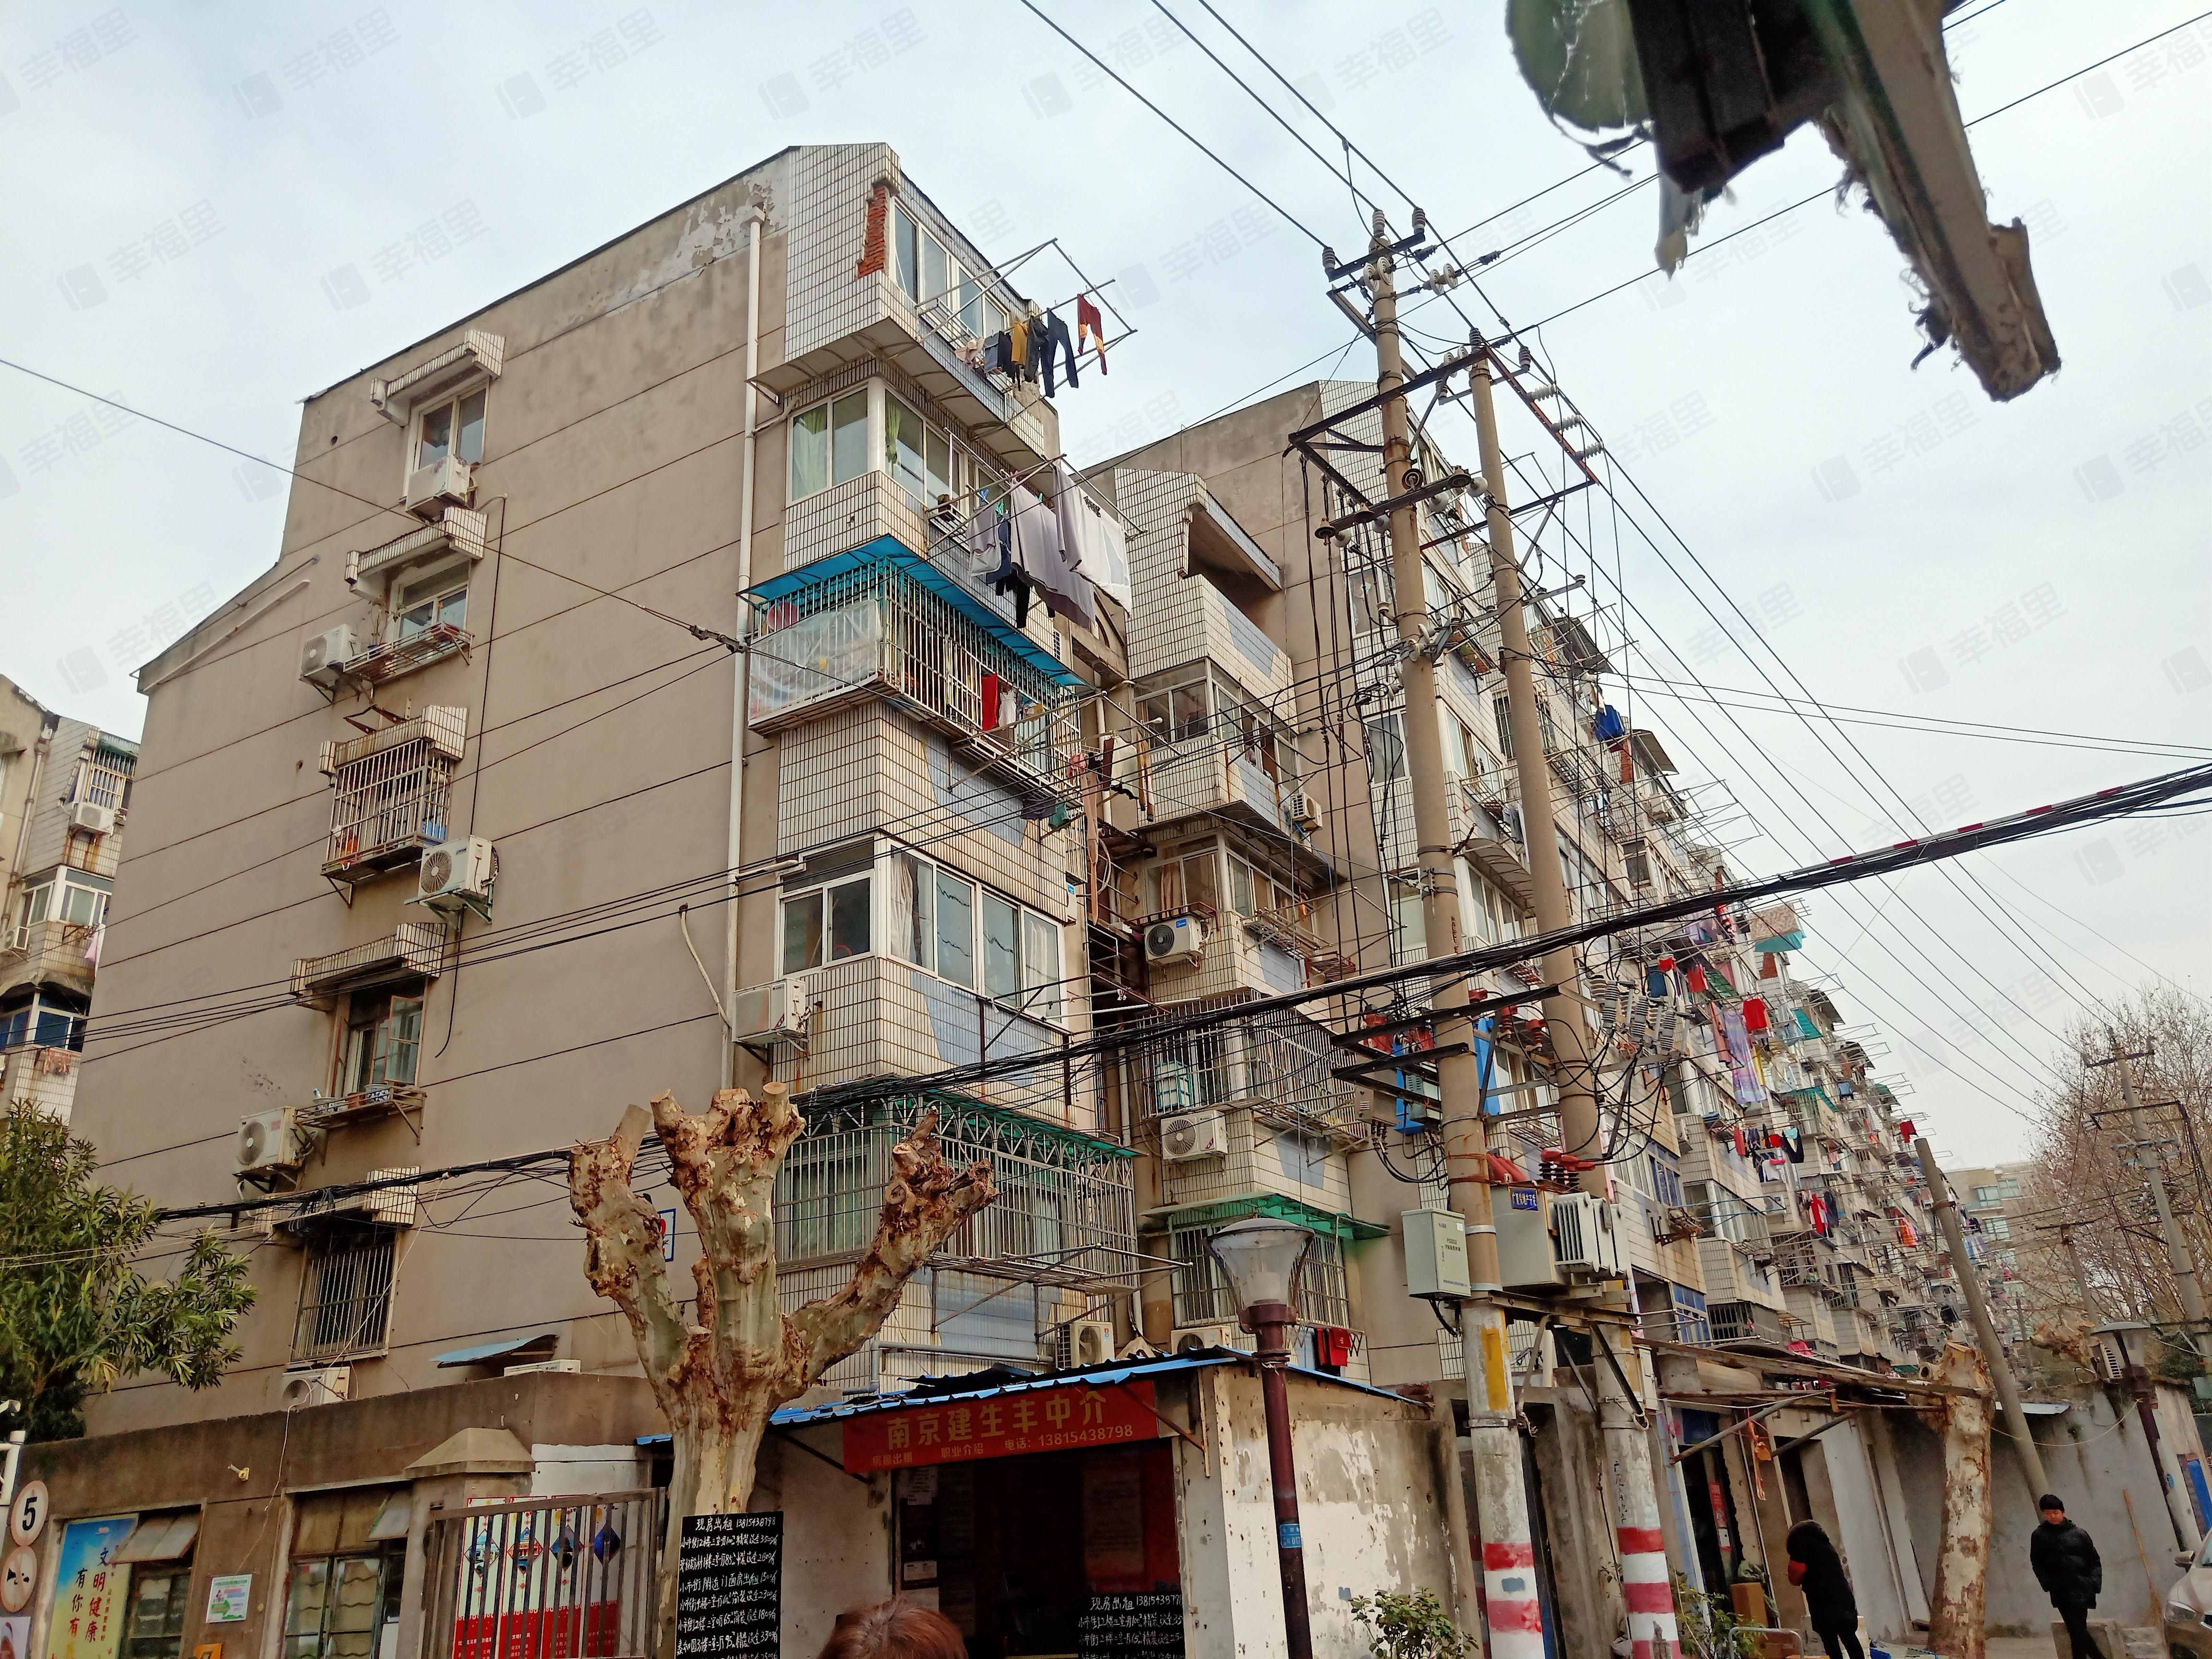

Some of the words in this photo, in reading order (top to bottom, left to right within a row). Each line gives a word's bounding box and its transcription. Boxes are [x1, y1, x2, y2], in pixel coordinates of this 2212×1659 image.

[887, 1391, 1106, 1450] 南京建生丰中介
[873, 1452, 912, 1467] 房屋出租
[941, 1443, 984, 1458] 职业介绍
[1039, 1424, 1133, 1446] 13815438798
[22, 1496, 37, 1530] 5
[696, 1515, 733, 1532] 现房出租
[736, 1516, 776, 1528] 13815438798
[85, 1548, 109, 1643] 文明健康
[1090, 1596, 1135, 1611] 现房出租
